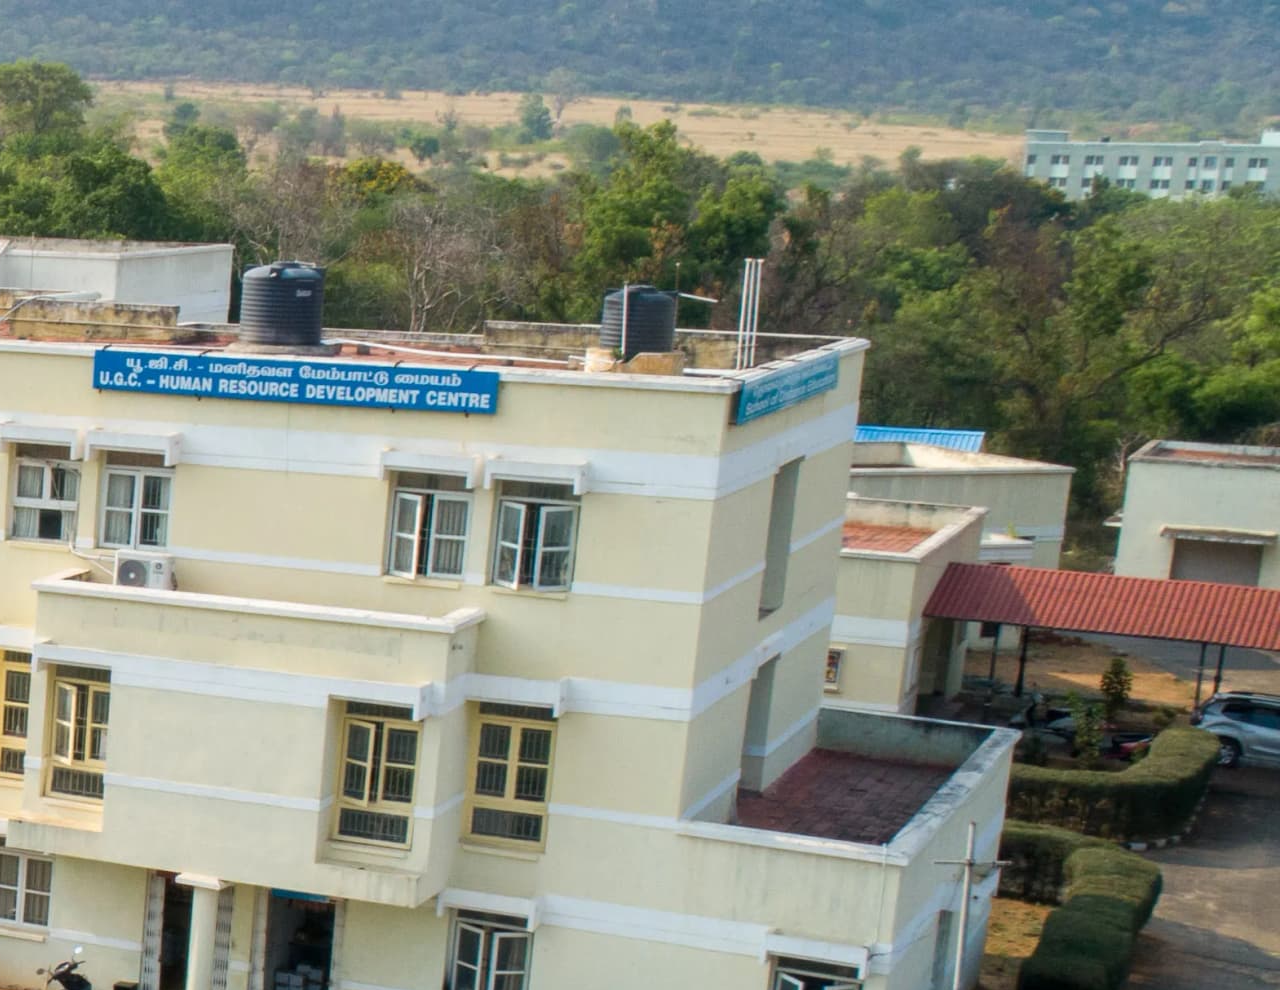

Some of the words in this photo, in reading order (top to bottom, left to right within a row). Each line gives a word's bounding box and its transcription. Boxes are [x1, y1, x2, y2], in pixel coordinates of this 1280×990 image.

[209, 361, 293, 377] மனிதவள
[298, 365, 388, 384] மேம்பாட்டு
[394, 371, 462, 387] மையம்
[99, 371, 142, 388] U.G.C.
[159, 375, 212, 393] HUMAN
[218, 379, 299, 398] RESOURCE
[306, 385, 420, 405] DEVELOPMENT
[425, 390, 491, 410] CENTRE
